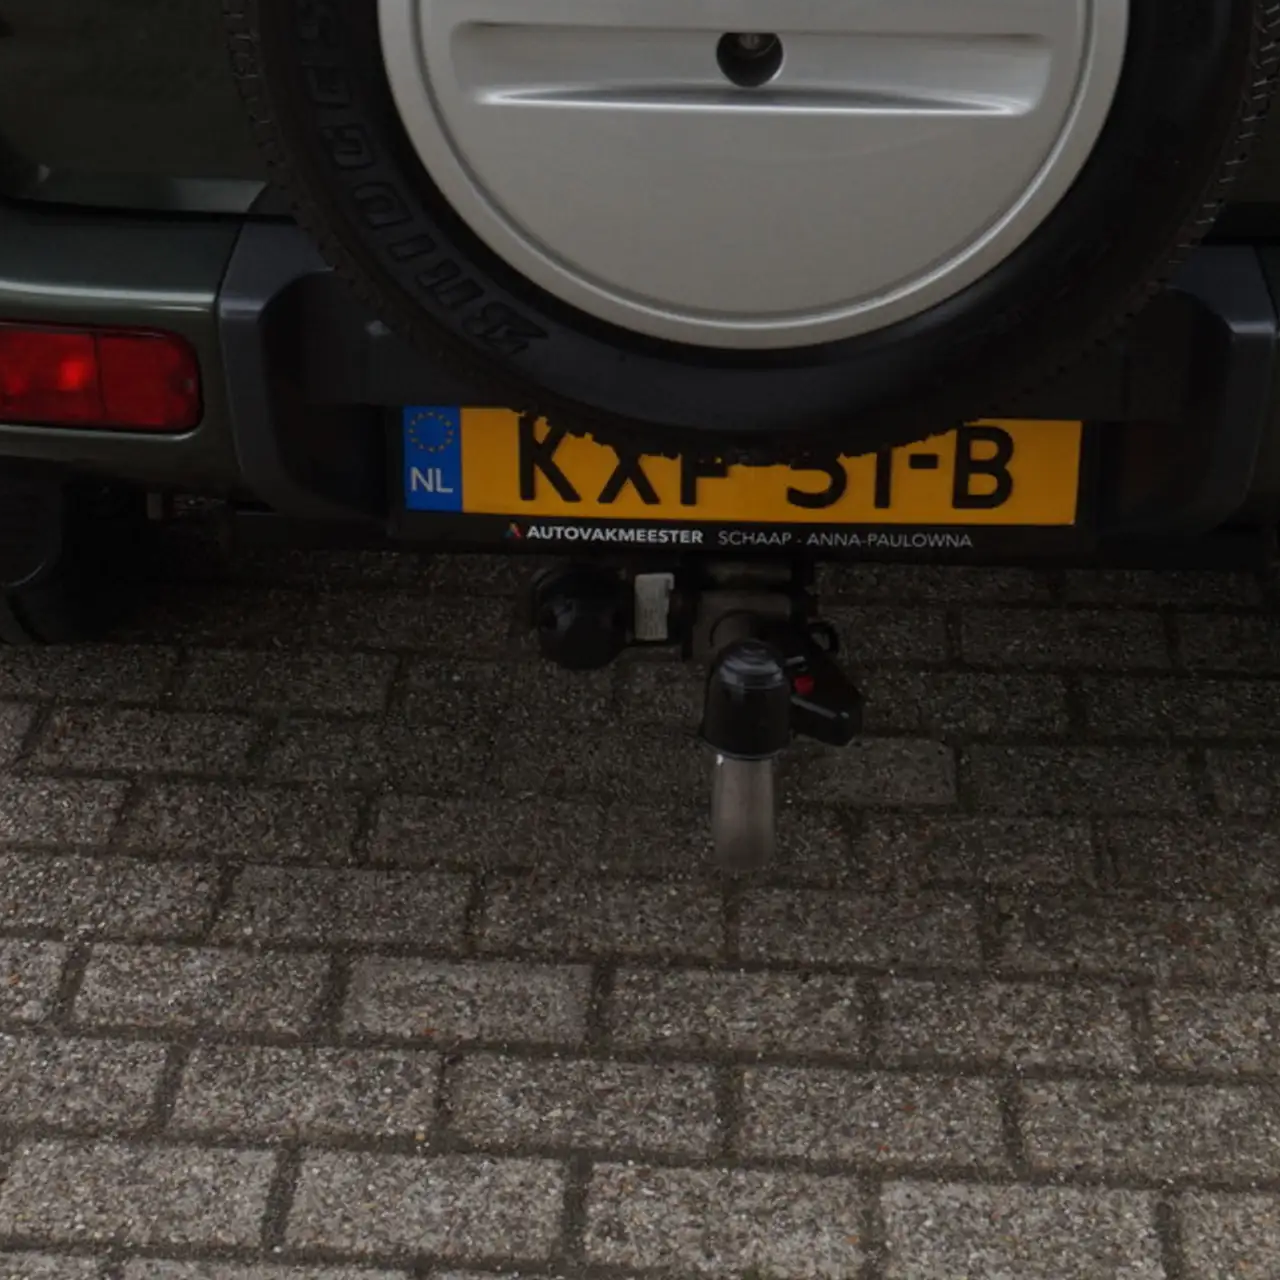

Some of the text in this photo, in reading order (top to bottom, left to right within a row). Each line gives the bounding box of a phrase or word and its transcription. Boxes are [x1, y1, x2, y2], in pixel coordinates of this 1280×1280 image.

[411, 467, 453, 493] NL
[526, 524, 704, 544] AUTOVAKMEESTER
[717, 530, 793, 546] SCHAAP
[807, 531, 973, 549] ANNA-PAULOWNA
